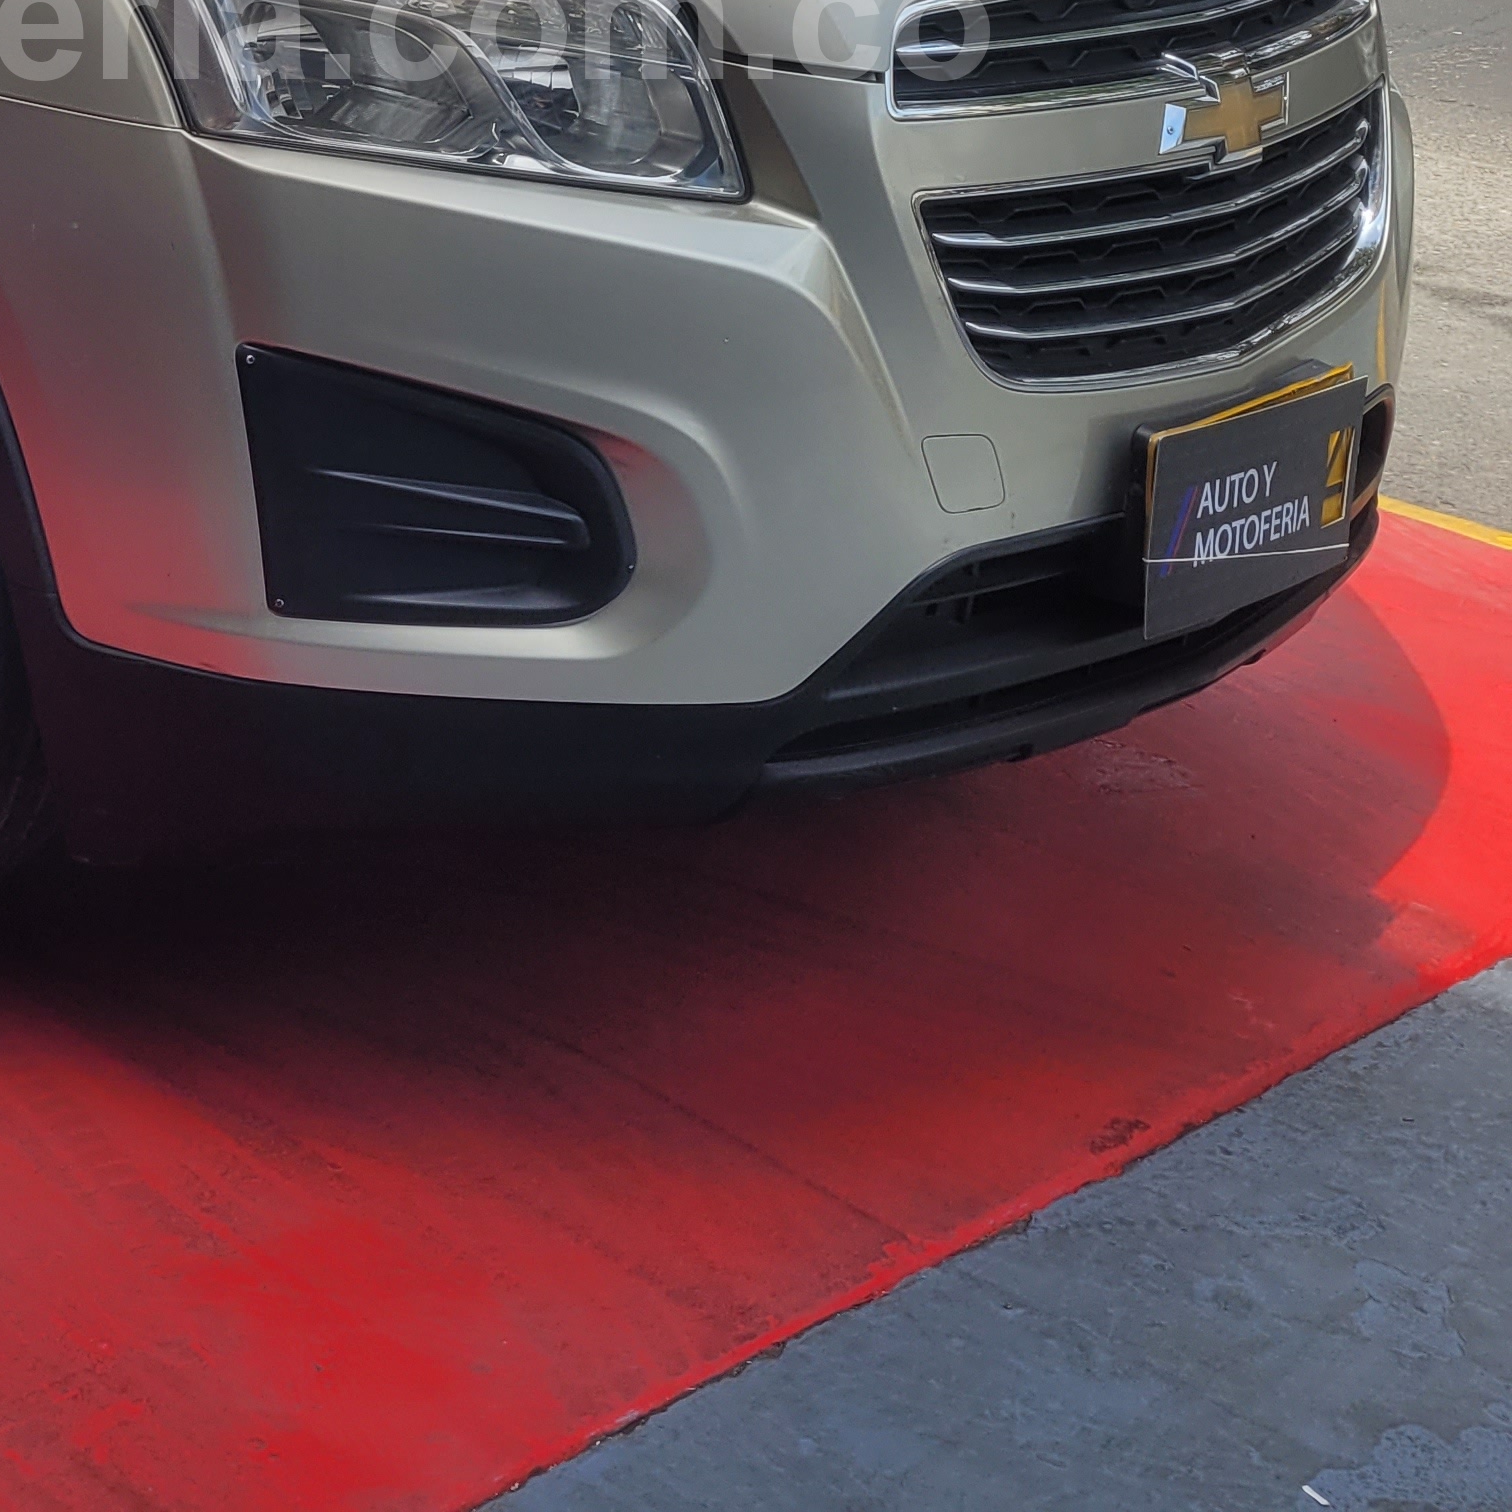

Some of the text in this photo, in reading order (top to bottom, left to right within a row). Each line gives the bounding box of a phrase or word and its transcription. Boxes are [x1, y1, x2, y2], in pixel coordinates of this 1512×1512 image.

[1196, 461, 1278, 519] AUTO Y
[1192, 495, 1310, 568] MOTOFERIA
